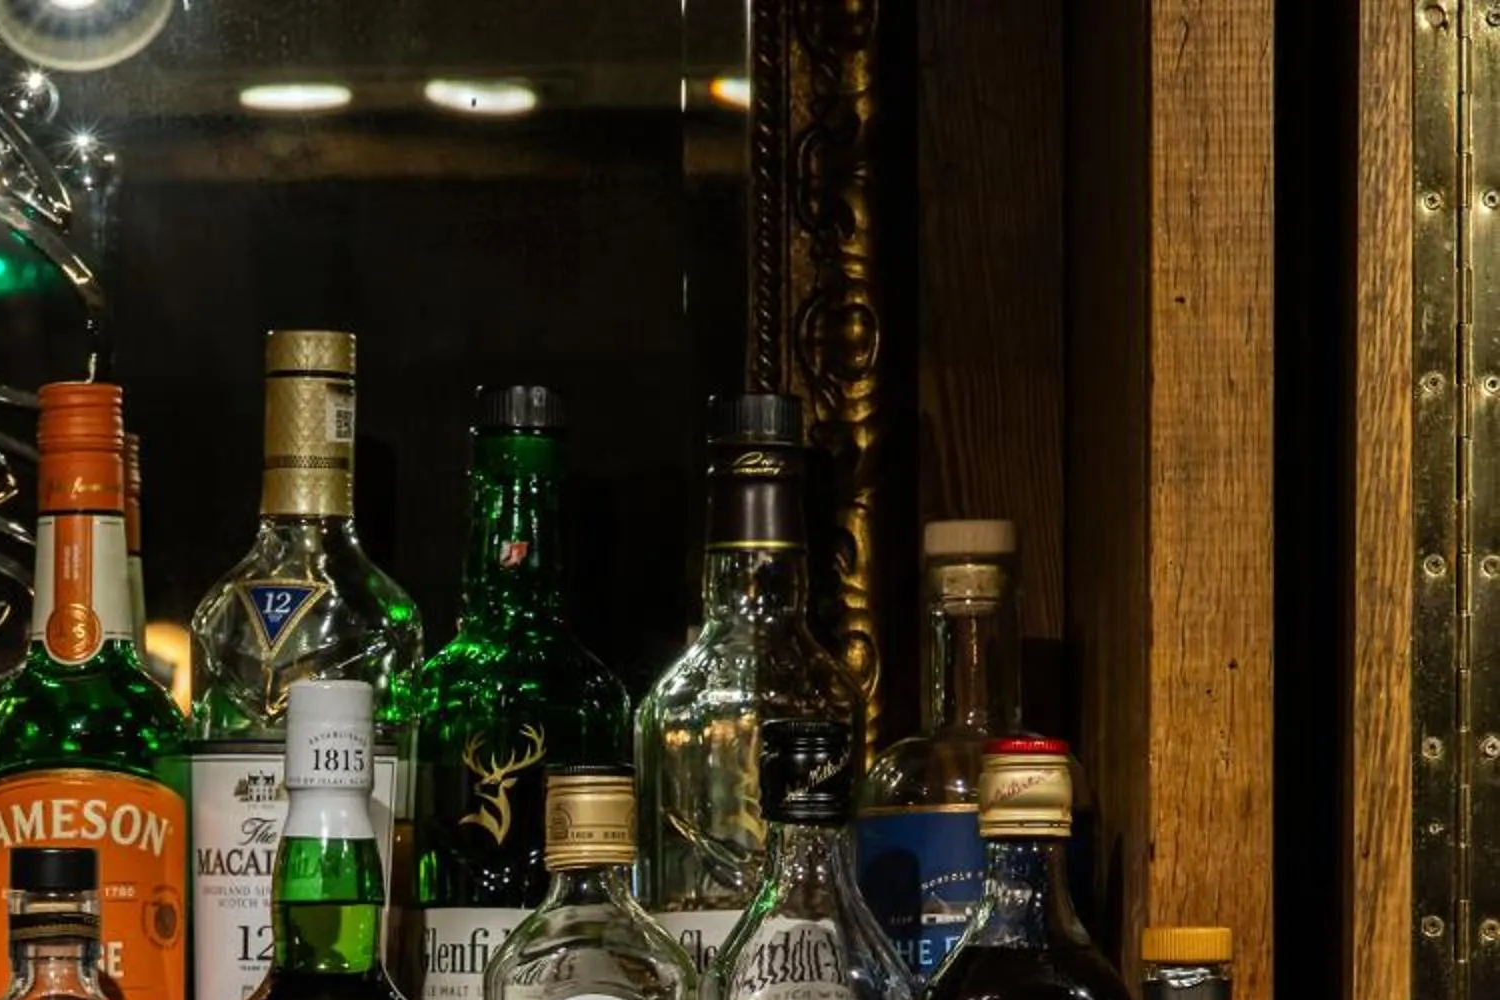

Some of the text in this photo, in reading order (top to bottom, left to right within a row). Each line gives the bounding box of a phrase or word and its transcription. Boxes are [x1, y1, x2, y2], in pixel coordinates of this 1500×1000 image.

[263, 592, 291, 613] 12
[313, 749, 365, 772] 1815
[237, 817, 277, 846] The
[237, 925, 275, 961] 12
[420, 927, 491, 974] Glenfi
[896, 938, 933, 966] HE
